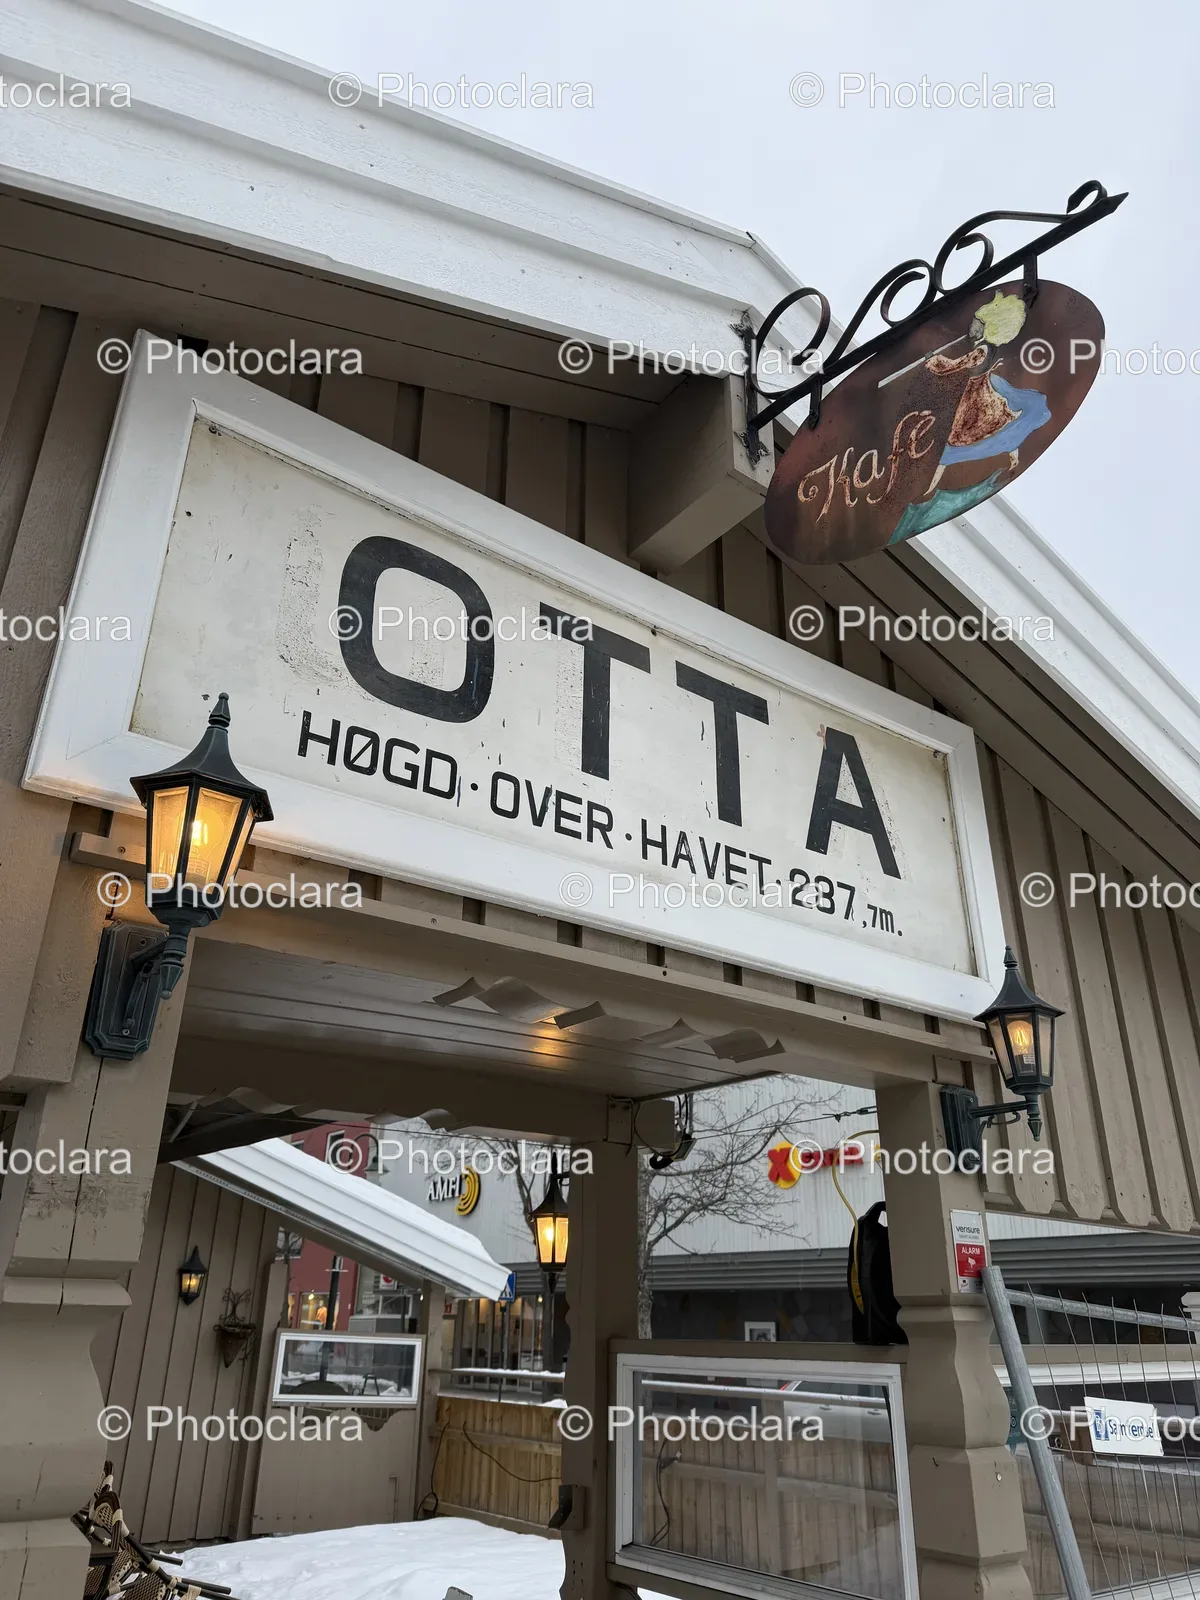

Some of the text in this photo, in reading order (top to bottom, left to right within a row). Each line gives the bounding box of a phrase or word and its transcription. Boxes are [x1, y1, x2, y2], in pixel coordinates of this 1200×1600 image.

[338, 535, 902, 880] OTTA
[297, 709, 458, 800] HØGD
[490, 770, 613, 850] OVER
[640, 818, 772, 896] HAVET
[426, 1174, 462, 1202] AMFI
[955, 1225, 981, 1235] verisure
[961, 1246, 981, 1255] ALARM
